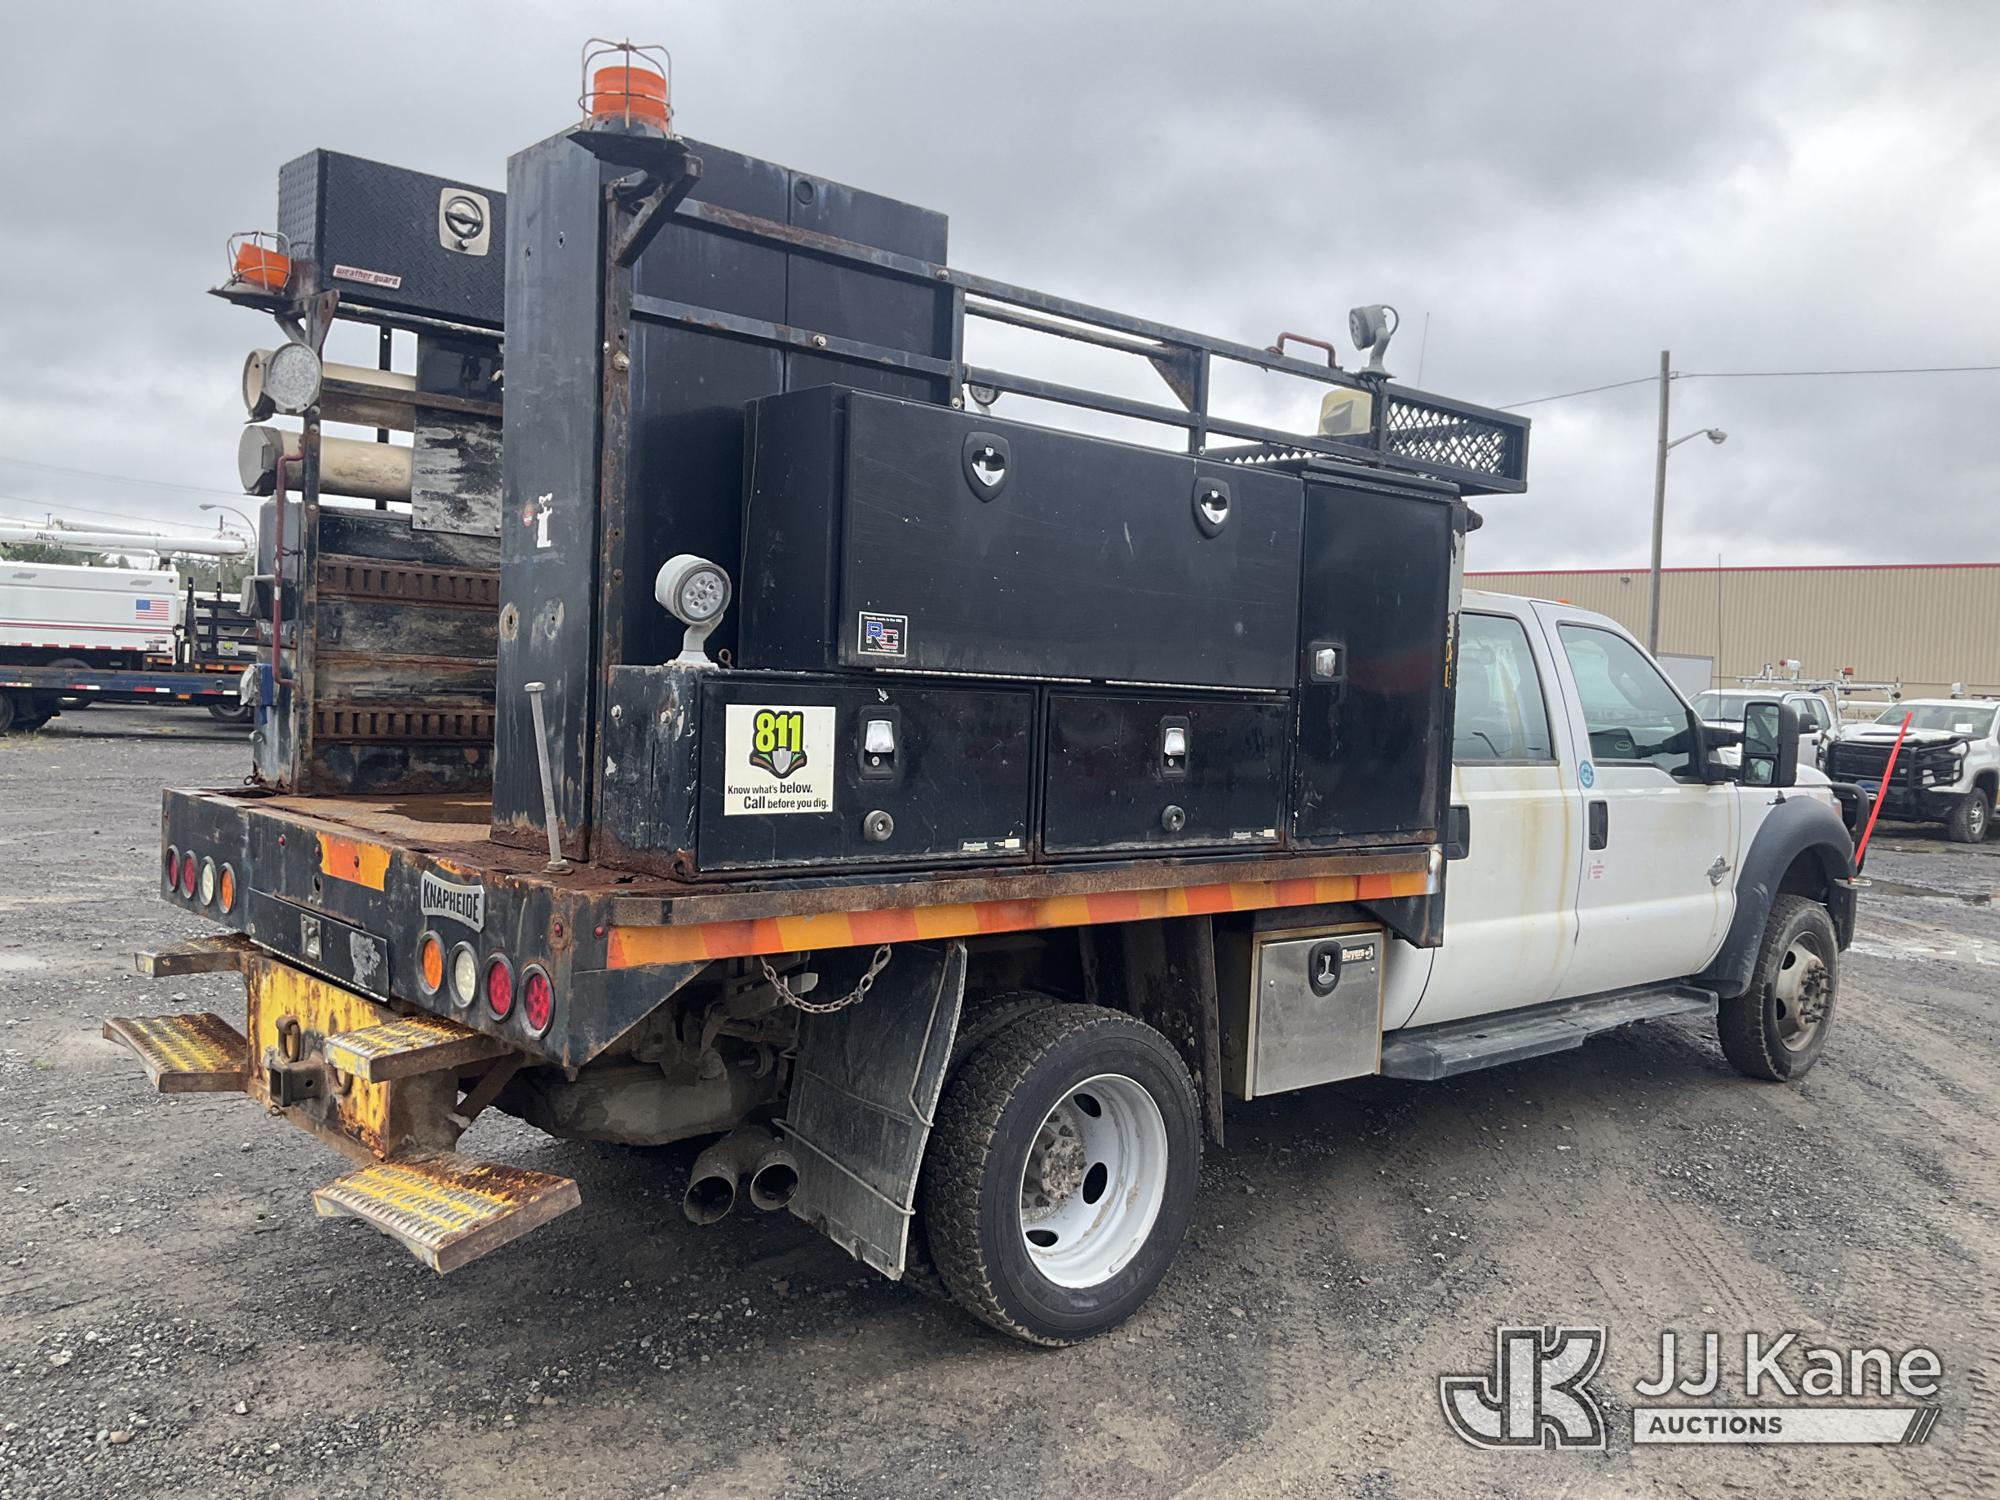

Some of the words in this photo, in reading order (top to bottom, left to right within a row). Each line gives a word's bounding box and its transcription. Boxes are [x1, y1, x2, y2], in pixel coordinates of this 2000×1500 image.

[336, 267, 373, 280] weather
[373, 275, 399, 287] guard
[753, 710, 803, 753] 811
[727, 785, 750, 795] Know
[751, 785, 778, 794] what's
[779, 782, 813, 794] below.
[743, 796, 766, 809] Call
[767, 799, 796, 809] before
[796, 802, 812, 810] you
[813, 798, 829, 810] dig.
[424, 879, 480, 925] KNAPHEIDE
